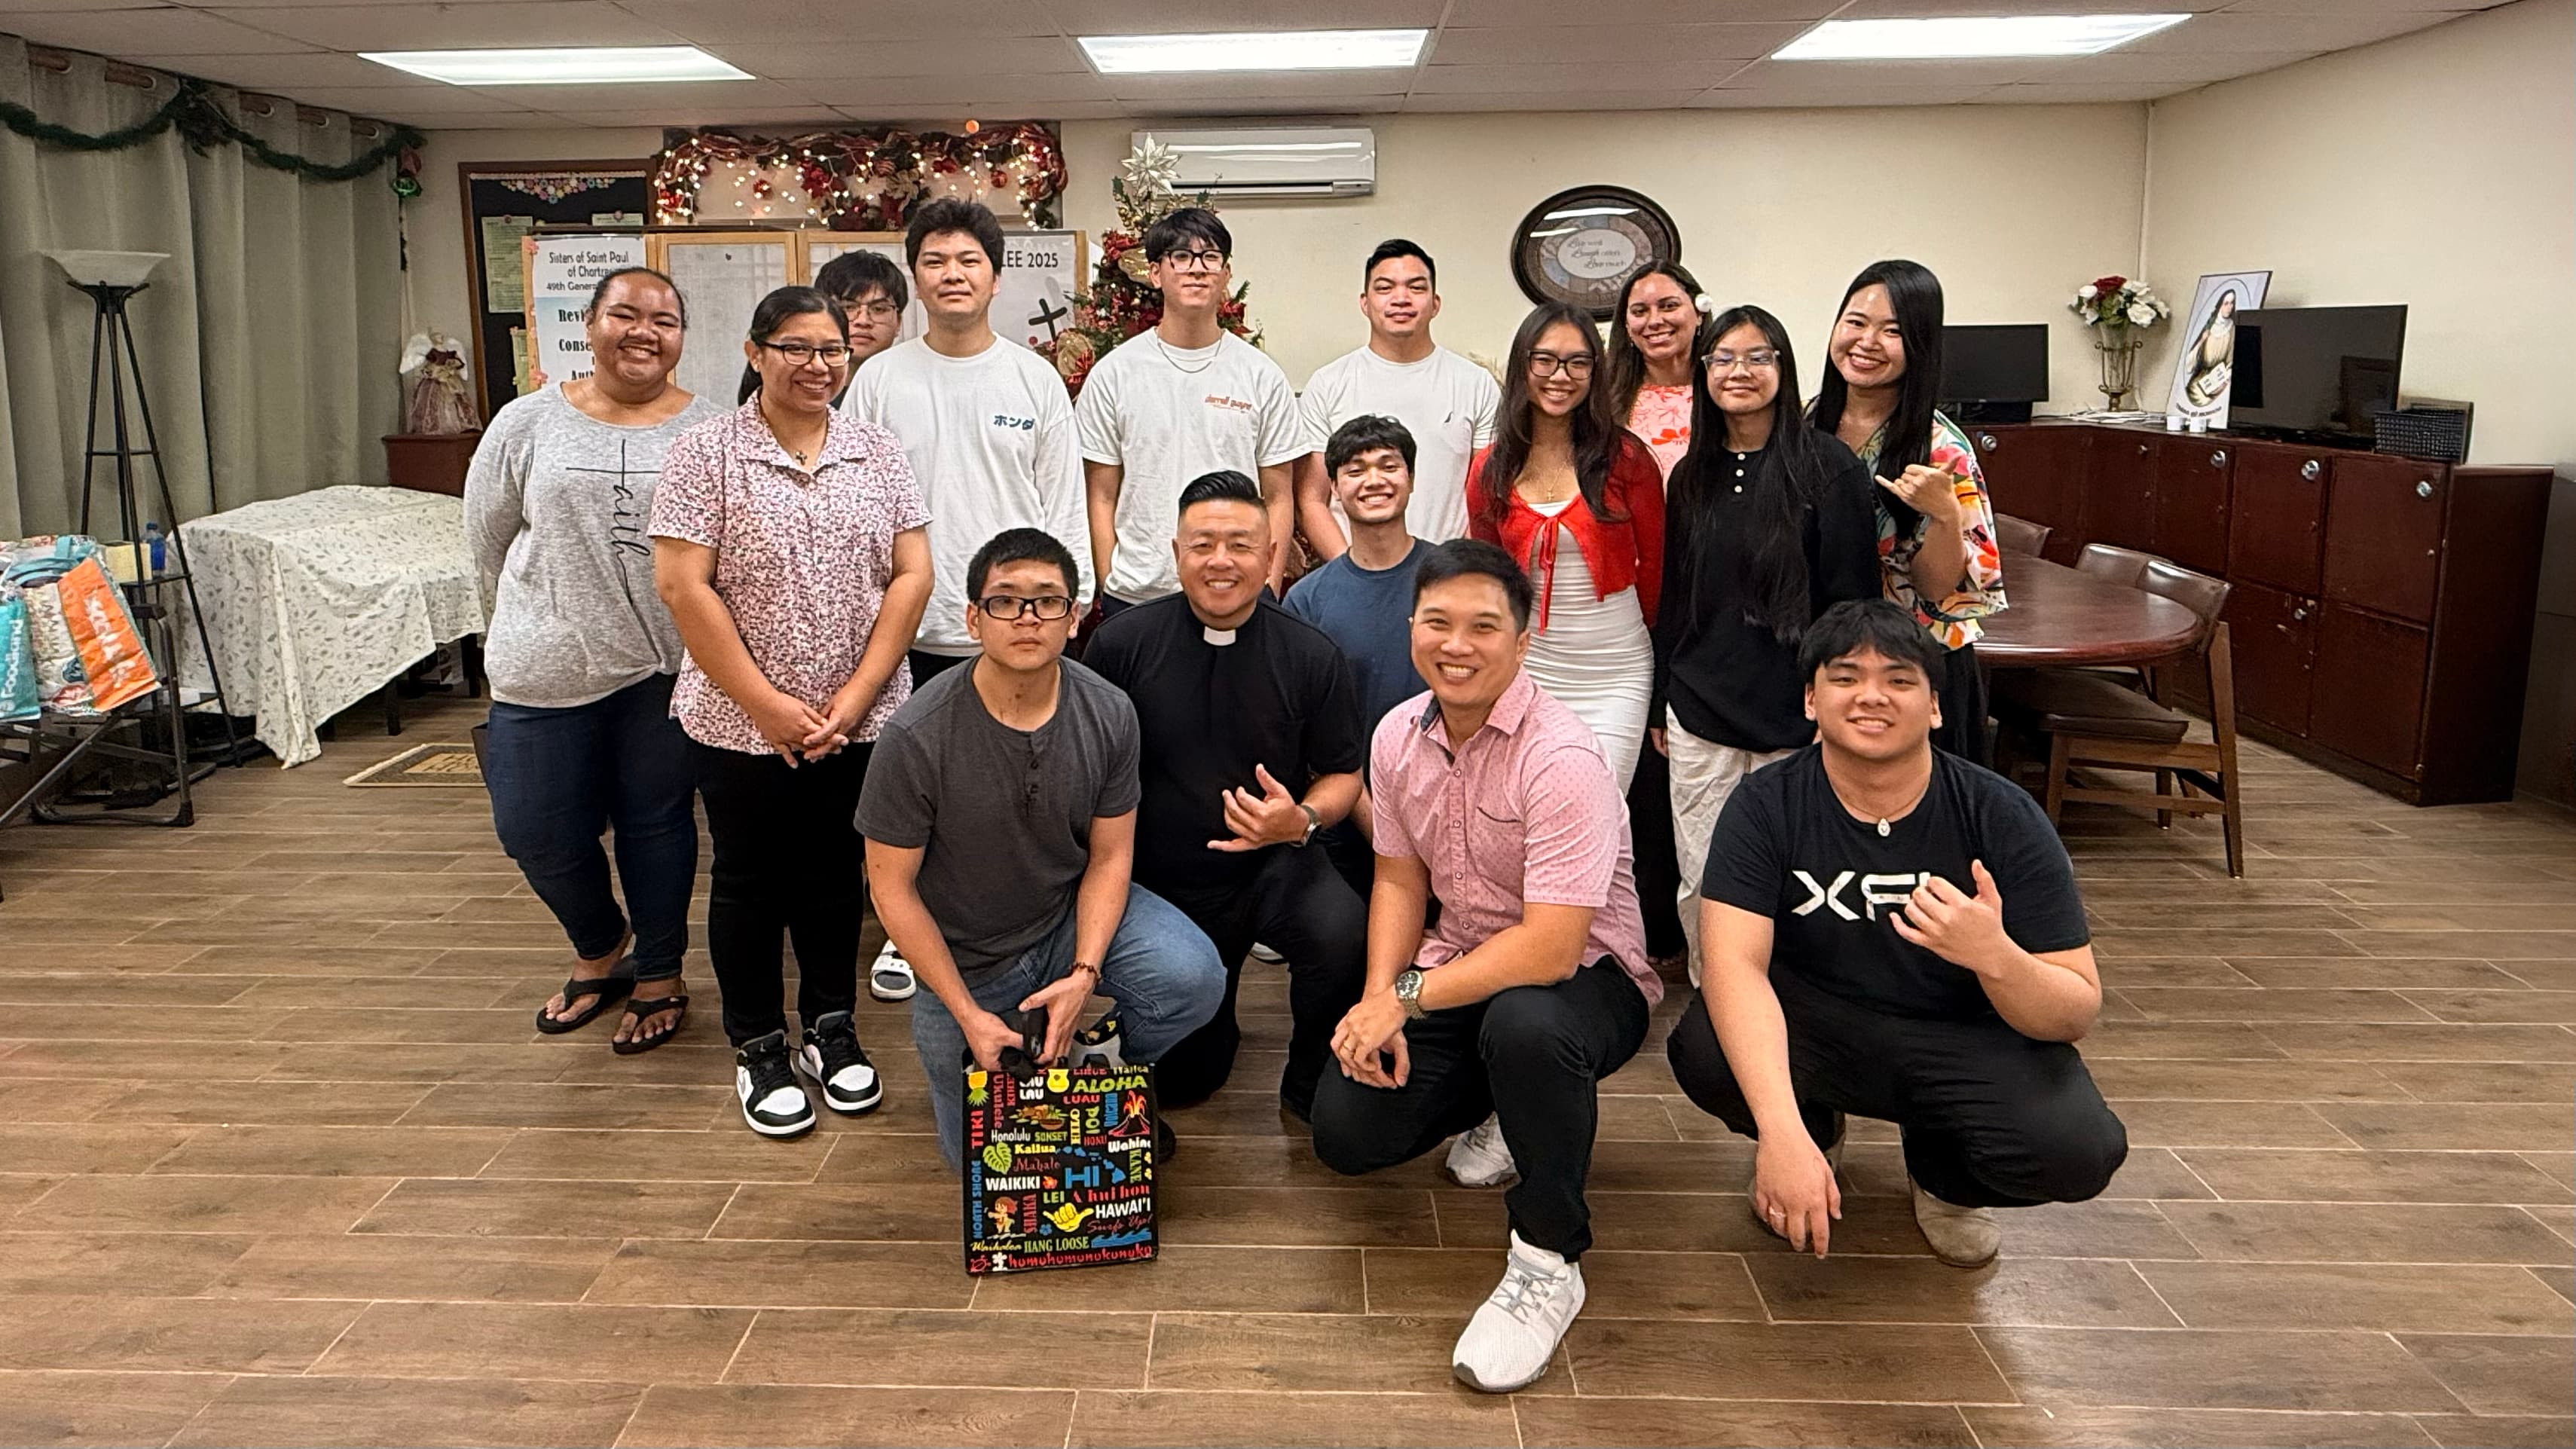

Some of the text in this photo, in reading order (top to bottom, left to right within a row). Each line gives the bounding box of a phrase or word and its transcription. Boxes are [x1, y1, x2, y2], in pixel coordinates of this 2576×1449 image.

[549, 251, 629, 264] Sisters of Saint Paul
[1027, 252, 1059, 268] 2025
[567, 265, 576, 277] of
[546, 281, 565, 290] 49th
[994, 414, 1035, 430] ホンダ
[1, 619, 24, 698] Foodland
[1073, 1075, 1147, 1093] ALOHA
[993, 1074, 1004, 1129] Ukulele
[1019, 1088, 1044, 1099] LAU
[1063, 1094, 1100, 1105] LUAU
[1071, 1108, 1081, 1145] HILO
[1085, 1106, 1100, 1134] POI
[971, 1110, 983, 1149] TIKI
[992, 1127, 1031, 1142] Honolulu
[1034, 1131, 1068, 1142] SUNSET
[1014, 1144, 1056, 1154] Kailua
[1013, 1157, 1061, 1172] Mahalo
[1129, 1148, 1141, 1183] KANE
[985, 1175, 1040, 1191] WAIKIKI
[1065, 1166, 1099, 1189] HI
[971, 1160, 982, 1239] NORTH SHORE
[1044, 1191, 1065, 1203] LEI
[1022, 1194, 1037, 1233] SHAKA
[1095, 1197, 1150, 1219] HAWAI'I
[1024, 1236, 1089, 1253] HANG LOOSE
